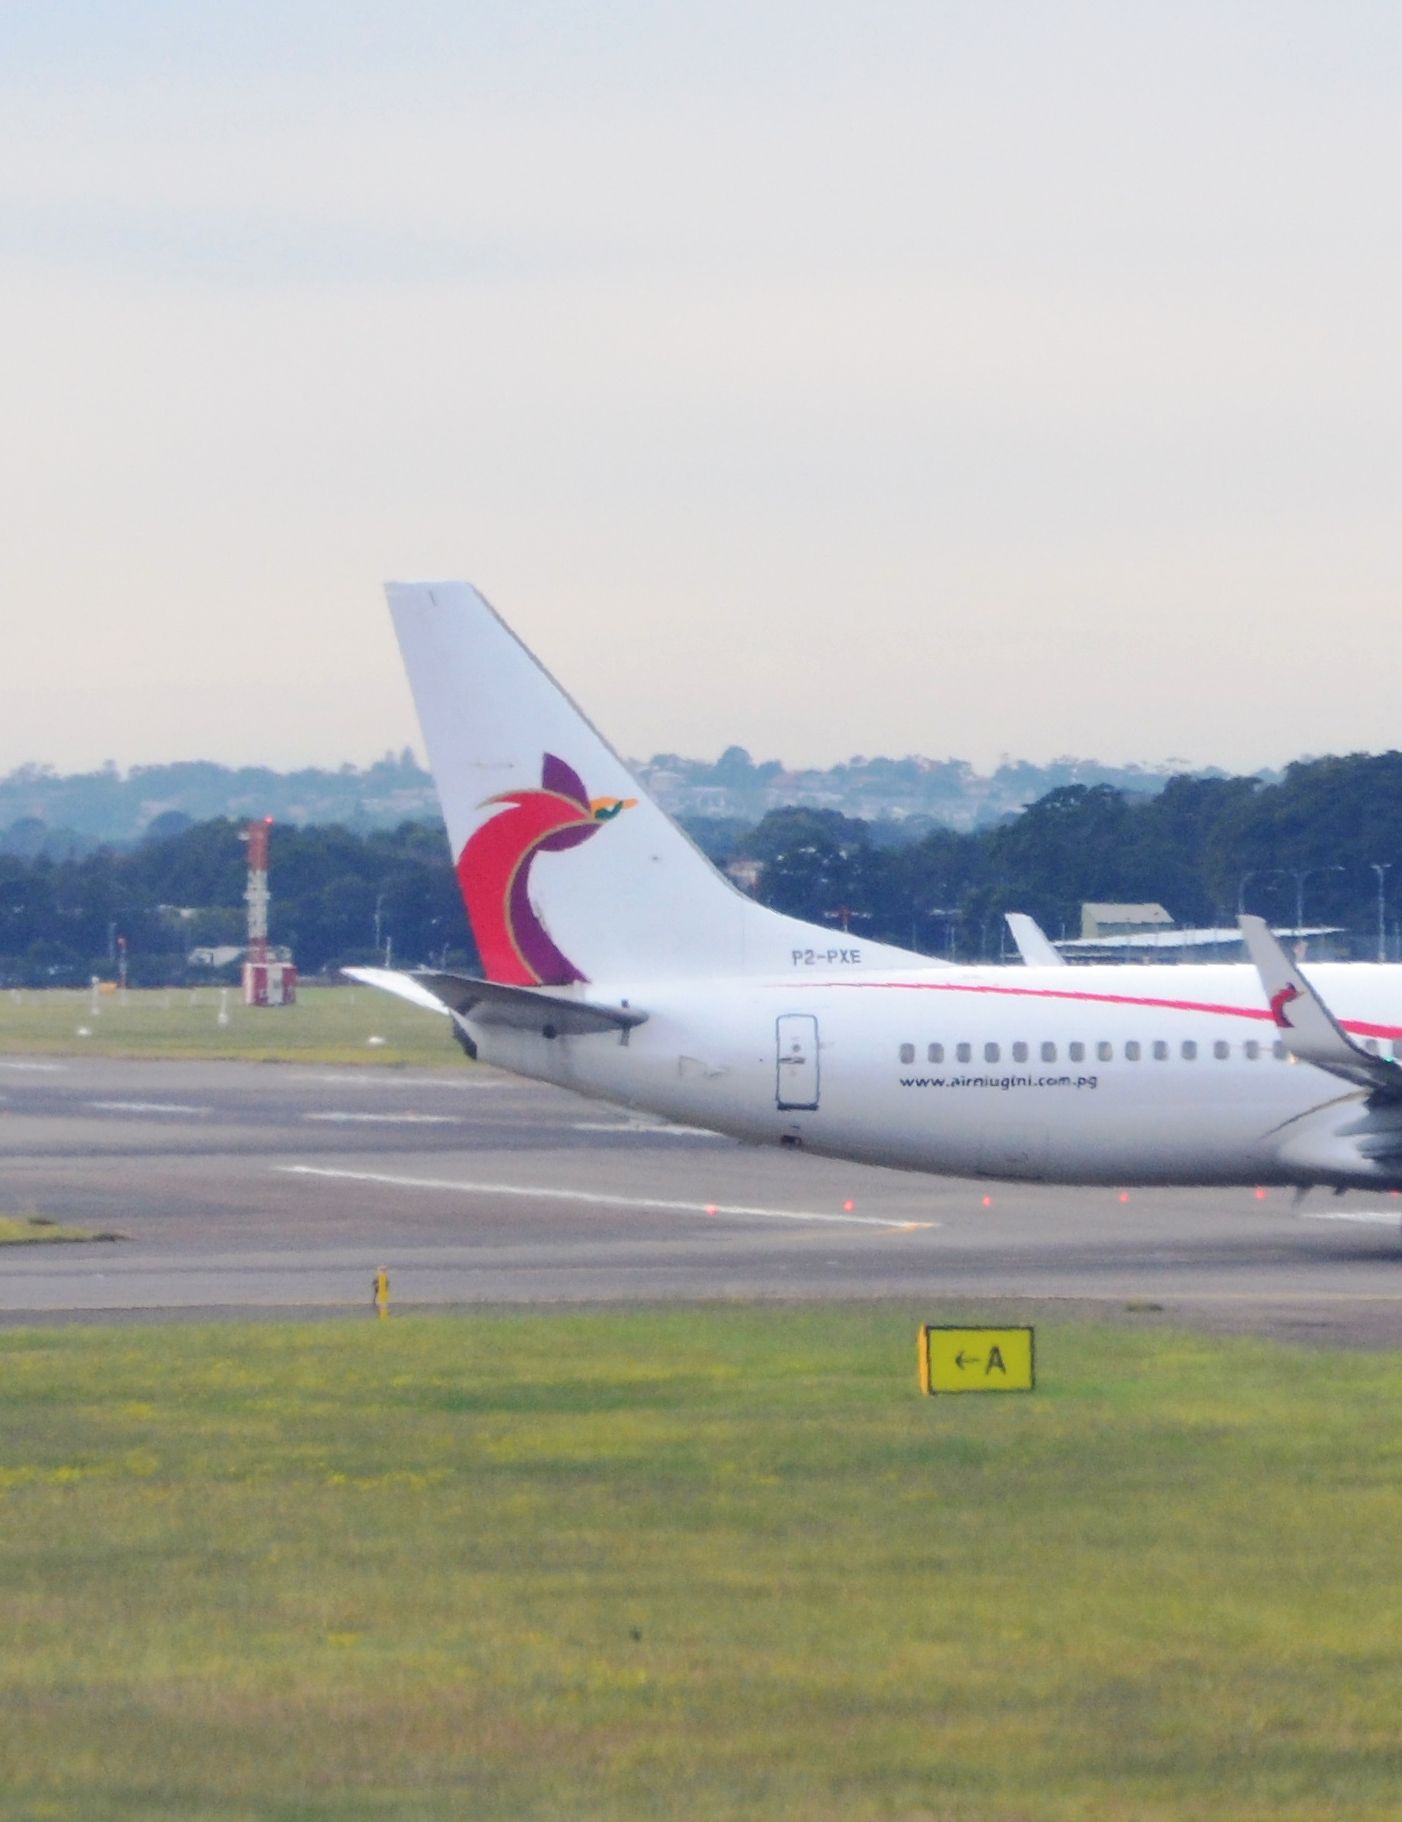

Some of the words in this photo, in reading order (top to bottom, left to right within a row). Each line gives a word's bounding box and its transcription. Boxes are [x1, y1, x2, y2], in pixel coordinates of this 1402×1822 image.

[792, 949, 862, 964] P2-PXE
[899, 1074, 1098, 1092] www.airniugini.com.pg
[984, 1345, 1007, 1376] A
